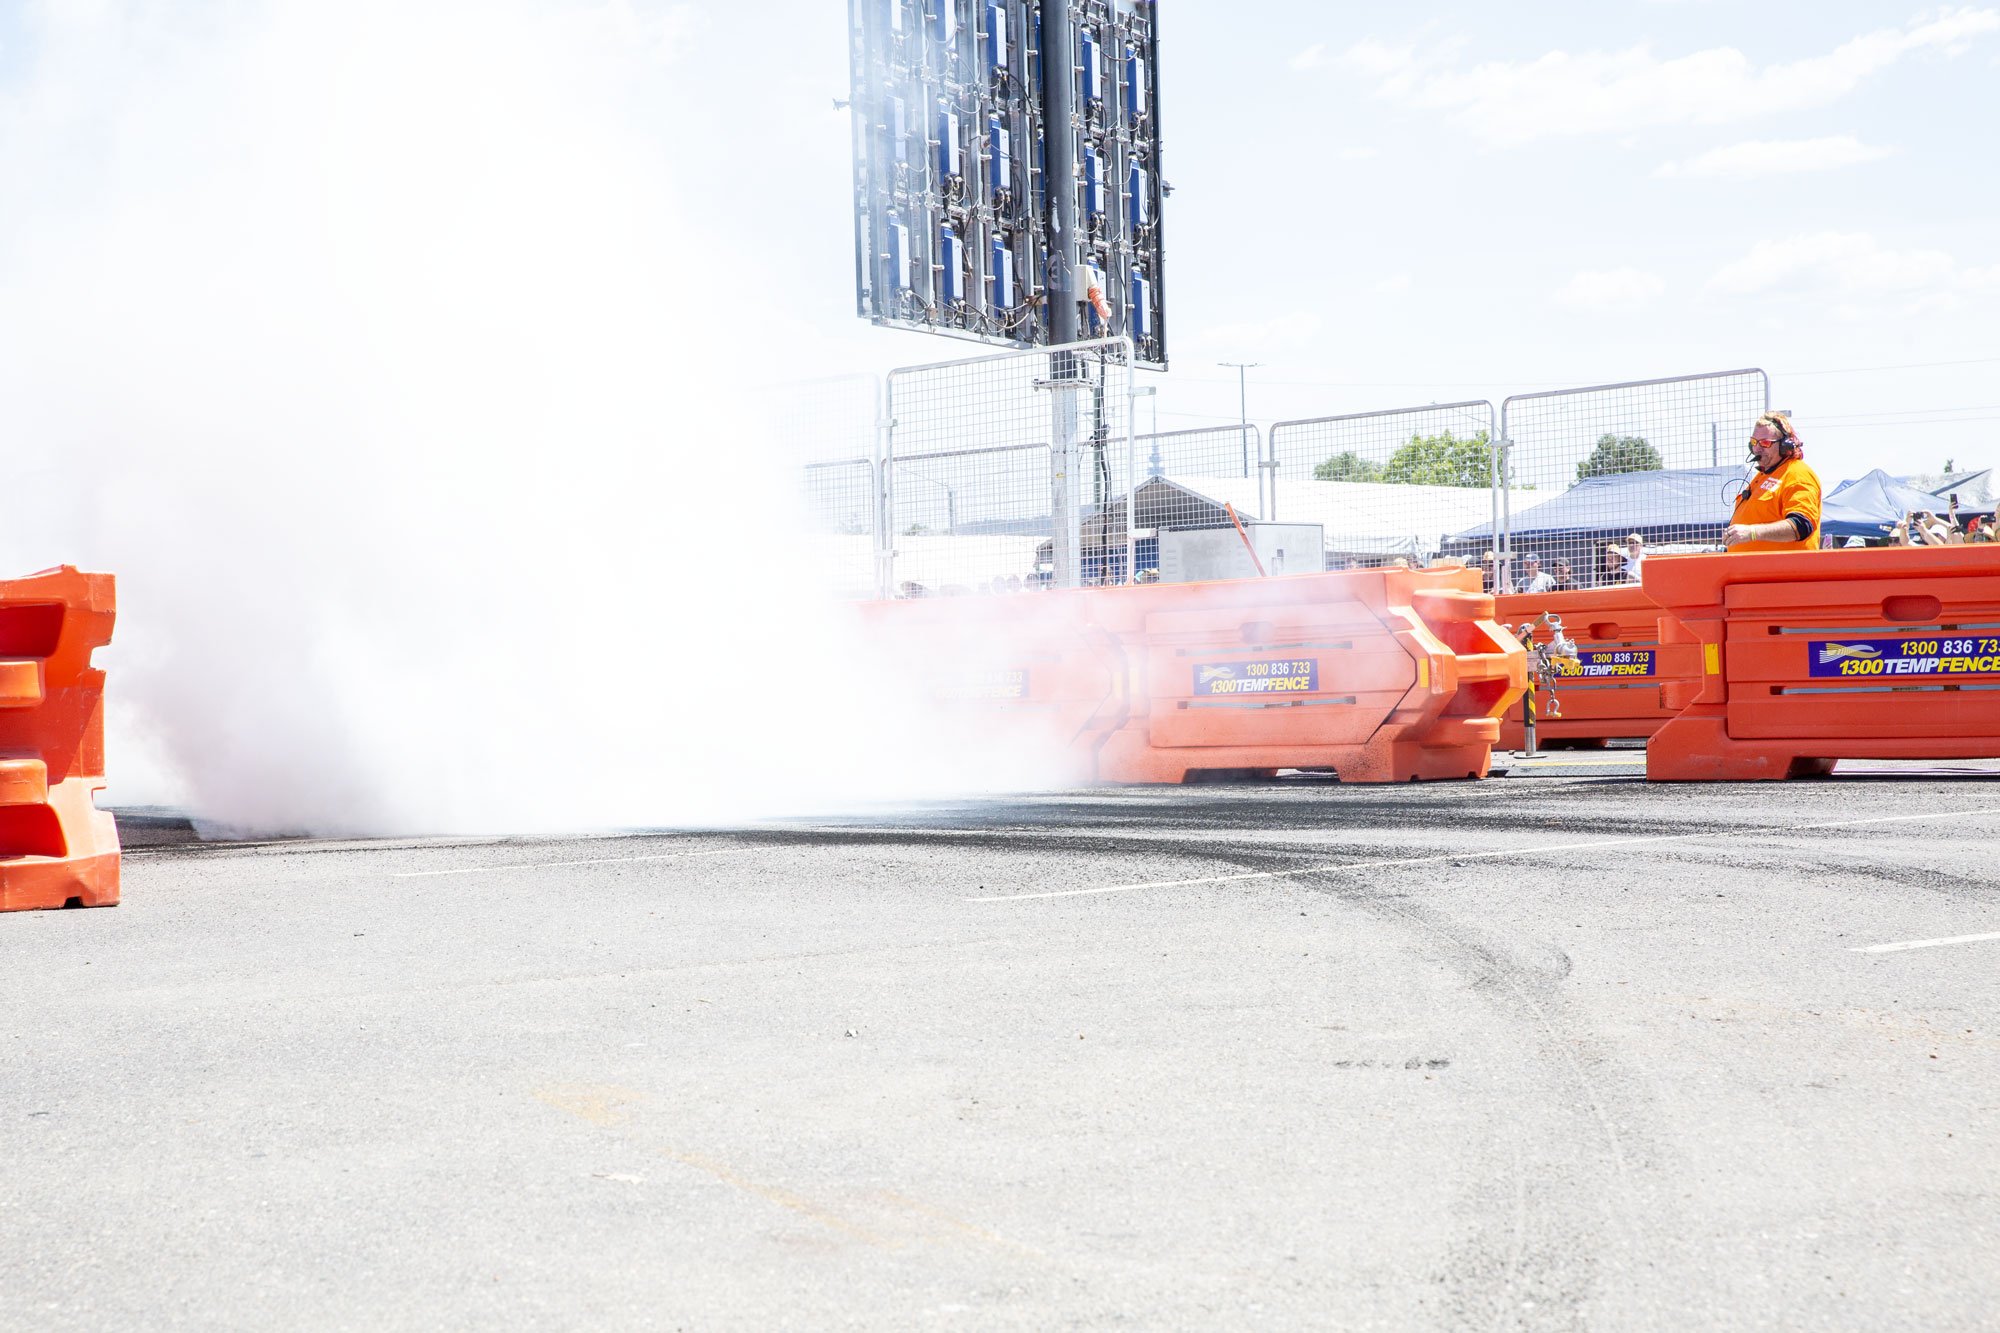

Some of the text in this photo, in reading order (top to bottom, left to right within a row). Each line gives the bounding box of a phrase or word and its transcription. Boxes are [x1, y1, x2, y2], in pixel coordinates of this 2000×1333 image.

[1901, 639, 2000, 655] 1300 836 73
[1592, 652, 1649, 663] 1300 836 733
[1839, 656, 2000, 675] 1300TEMPFENCE
[1246, 661, 1311, 676] 1300 836 733
[1210, 676, 1310, 693] 1300TEMPFENCE
